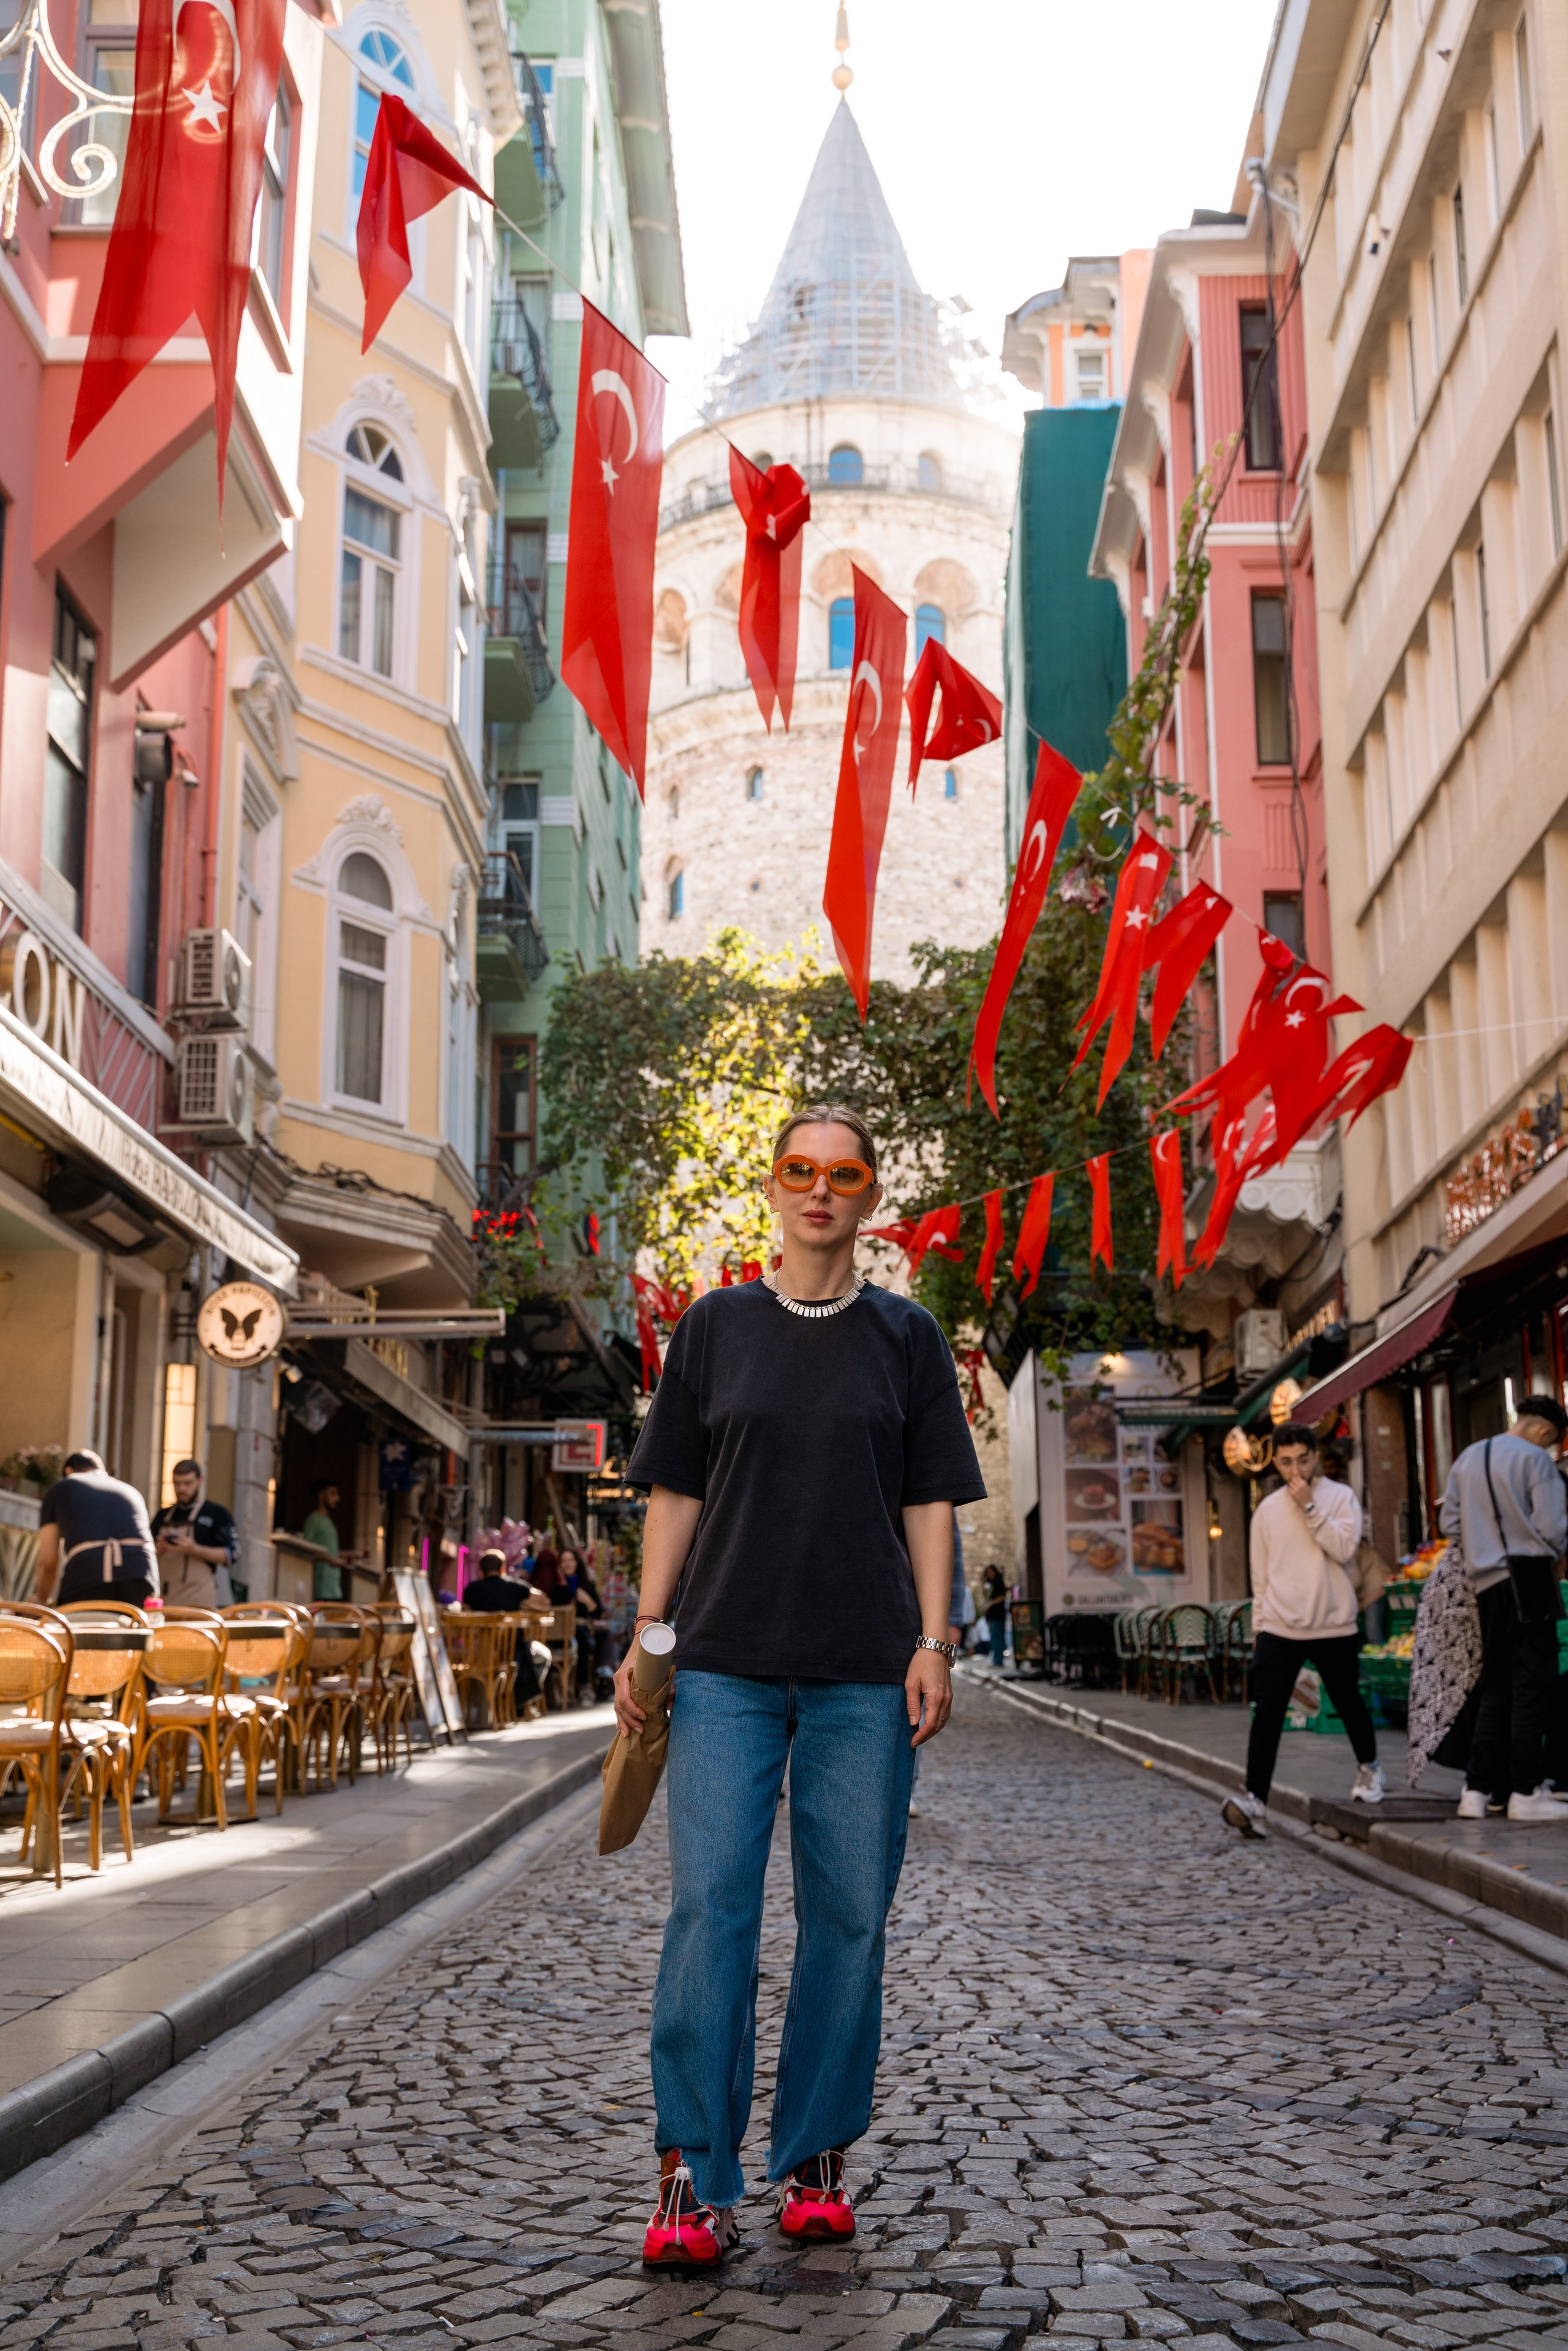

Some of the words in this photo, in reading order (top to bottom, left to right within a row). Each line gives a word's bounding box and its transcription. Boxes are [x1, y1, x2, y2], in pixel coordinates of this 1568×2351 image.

[0, 930, 86, 1072] ON
[206, 1290, 228, 1314] ROSE
[232, 1286, 276, 1316] PAPILLON
